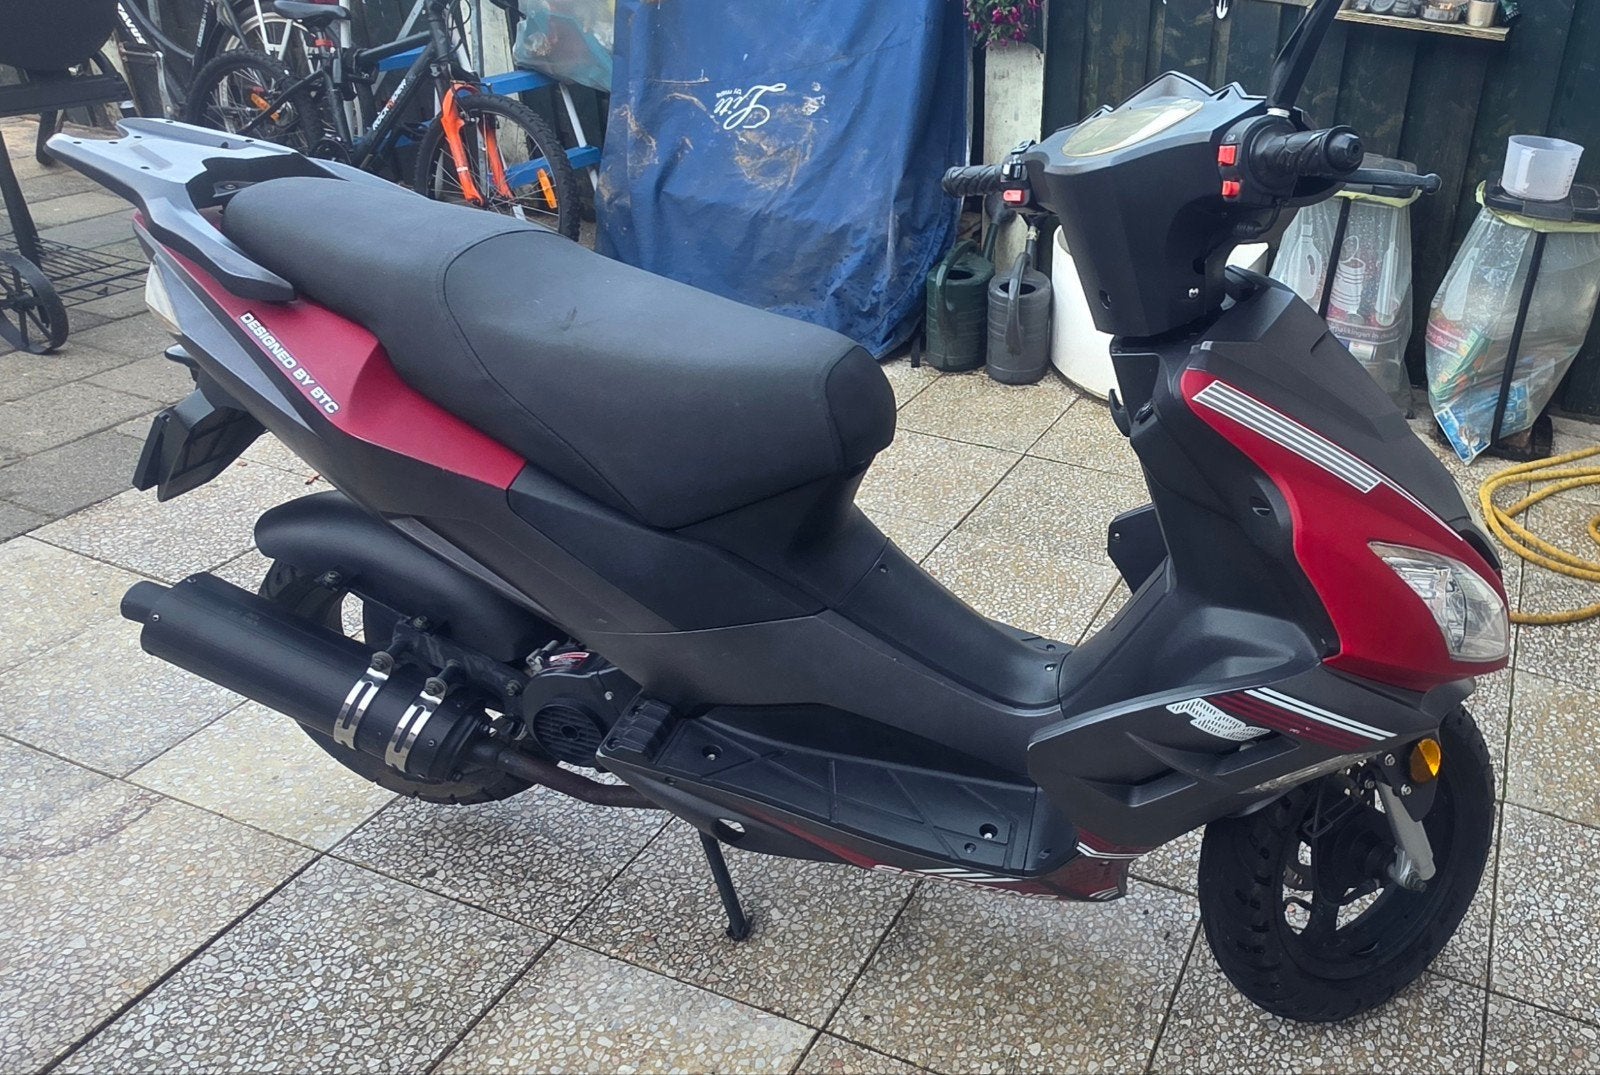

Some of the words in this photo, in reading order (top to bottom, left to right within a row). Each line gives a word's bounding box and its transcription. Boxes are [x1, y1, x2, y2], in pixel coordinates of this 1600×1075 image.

[240, 312, 297, 369] DESIGNED
[292, 367, 315, 386] BY
[310, 386, 339, 413] BTC
